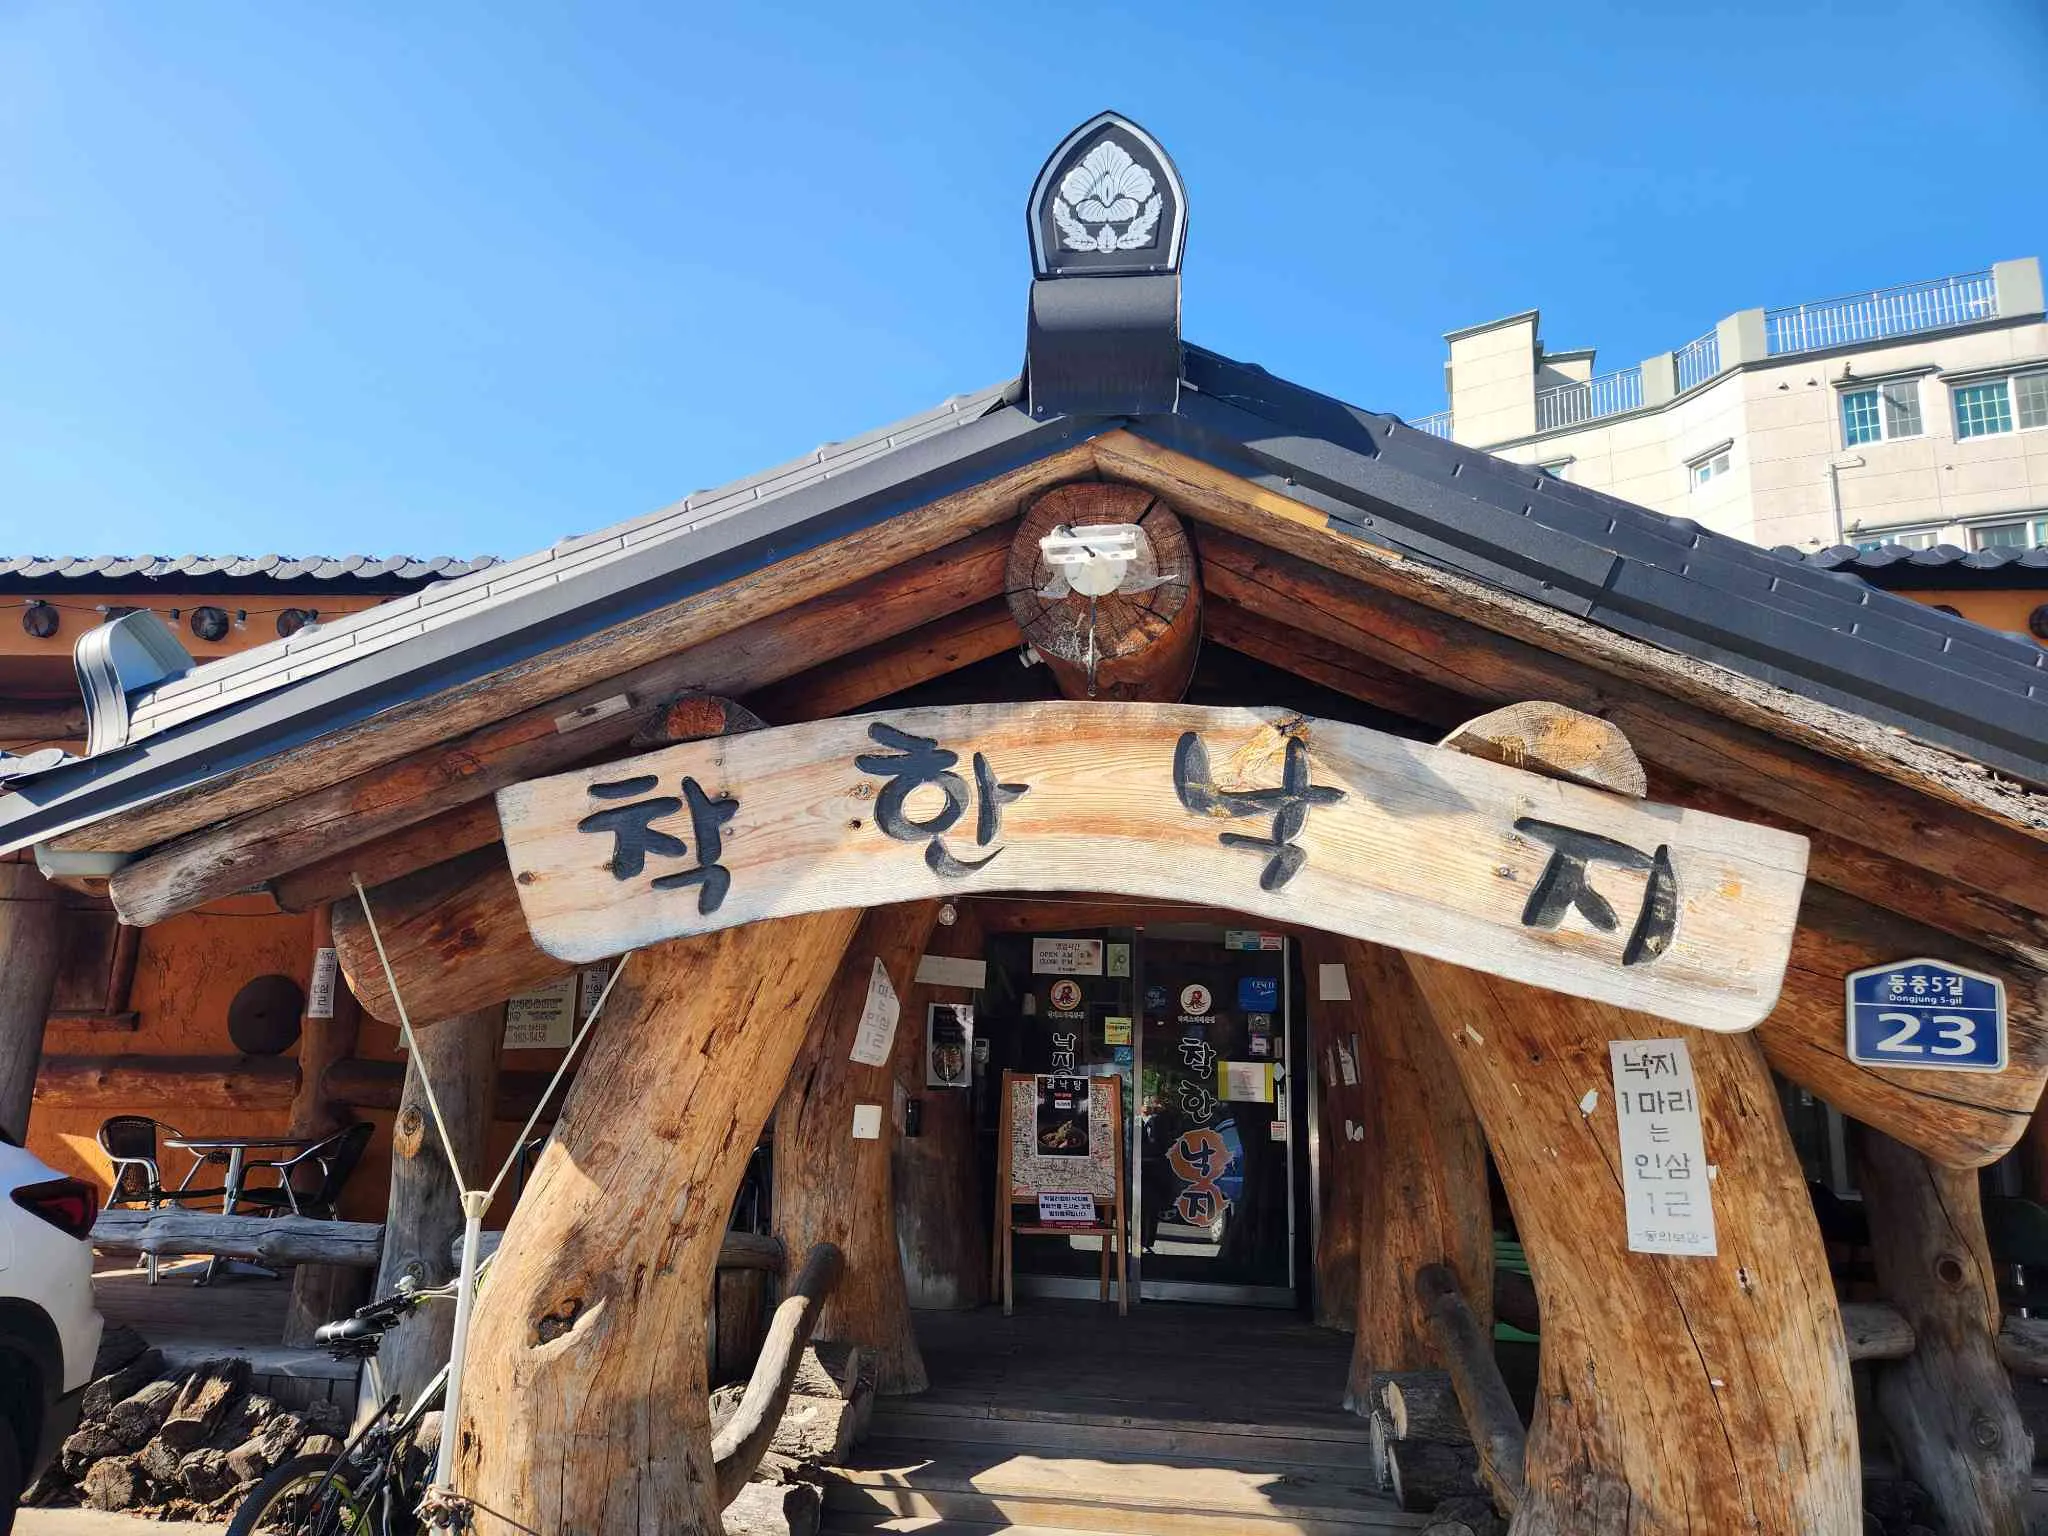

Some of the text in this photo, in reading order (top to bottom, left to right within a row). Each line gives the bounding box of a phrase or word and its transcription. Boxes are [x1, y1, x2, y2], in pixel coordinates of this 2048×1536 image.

[1040, 951, 1058, 959] OPEN
[1888, 975, 1964, 996] 동중5길
[1889, 994, 1963, 1006] Dongjung 5-gil
[1877, 1013, 1976, 1055] 23
[1623, 1053, 1678, 1079] 낙지
[1650, 1123, 1670, 1142] 는
[1635, 1153, 1690, 1179] 인삼
